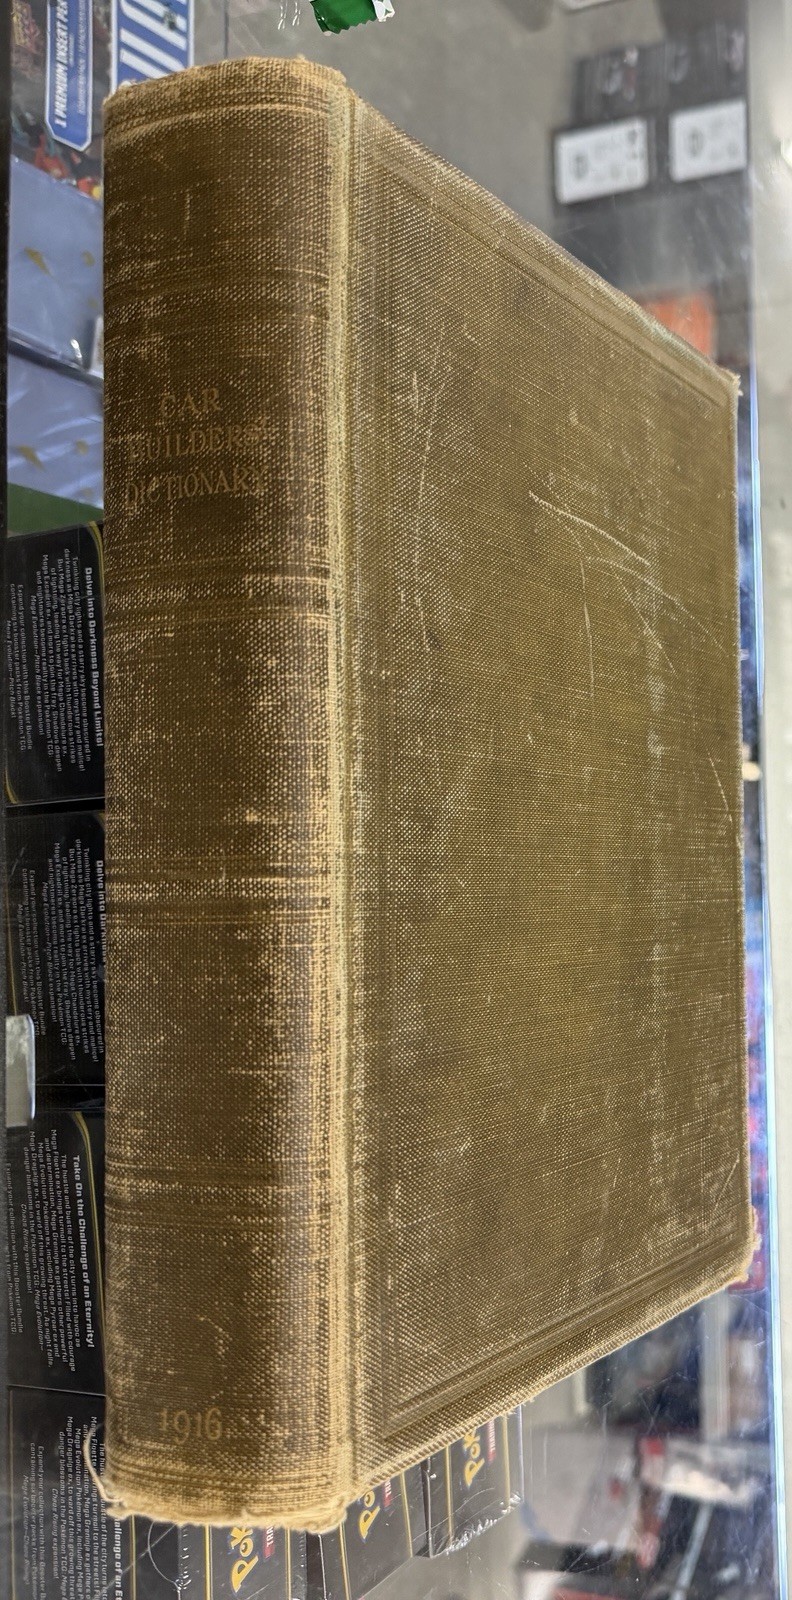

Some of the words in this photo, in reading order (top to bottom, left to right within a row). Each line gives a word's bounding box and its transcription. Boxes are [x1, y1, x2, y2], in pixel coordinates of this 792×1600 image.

[55, 21, 68, 65] INSERT
[54, 63, 67, 118] PREMIUM
[161, 388, 222, 418] CAR
[125, 465, 269, 507] DICTIONARY
[84, 565, 94, 596] Delve
[86, 596, 95, 618] into
[87, 619, 99, 669] Darkness
[89, 670, 101, 709] Beyond
[93, 709, 104, 747] Limits!
[95, 858, 105, 889] Delve
[97, 890, 106, 911] into
[72, 1154, 82, 1180] Take
[74, 1182, 83, 1197] On
[76, 1198, 85, 1216] the
[75, 1217, 89, 1270] Challenge
[81, 1271, 90, 1283] of
[82, 1284, 90, 1298] an
[82, 1299, 94, 1348] Eternity!
[159, 1408, 222, 1444] 1916
[114, 1560, 123, 1573] of
[114, 1574, 121, 1588] an
